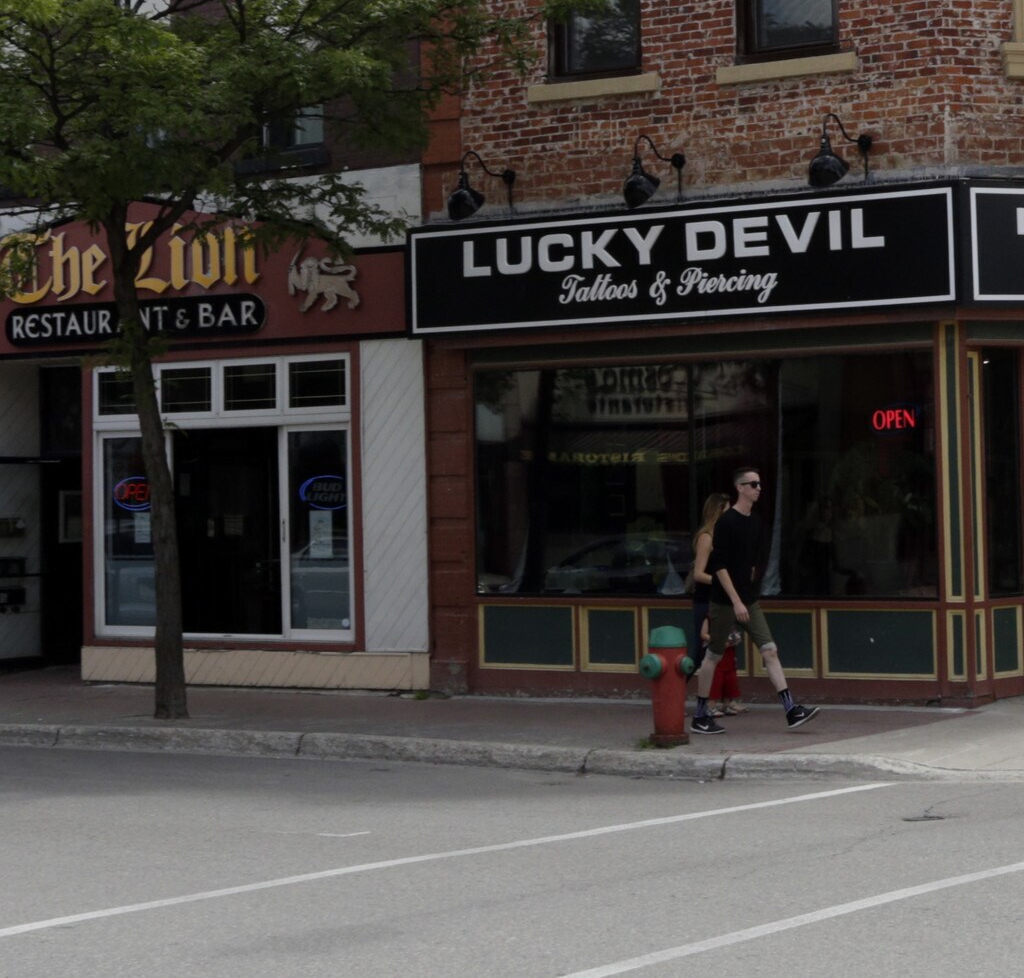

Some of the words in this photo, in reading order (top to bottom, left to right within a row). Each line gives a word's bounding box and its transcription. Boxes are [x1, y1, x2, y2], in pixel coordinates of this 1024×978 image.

[0, 228, 108, 304] The
[124, 220, 261, 294] Lion
[463, 225, 665, 277] LUCKY
[685, 208, 885, 261] DEVIL
[558, 273, 638, 305] Tattoos
[649, 270, 671, 306] &
[676, 267, 779, 303] Piercing
[12, 305, 169, 339] RESTAURNT
[176, 308, 190, 329] &
[199, 300, 259, 329] BAR
[872, 408, 916, 430] OPEN
[115, 483, 150, 501] OPE
[312, 482, 343, 492] BUD
